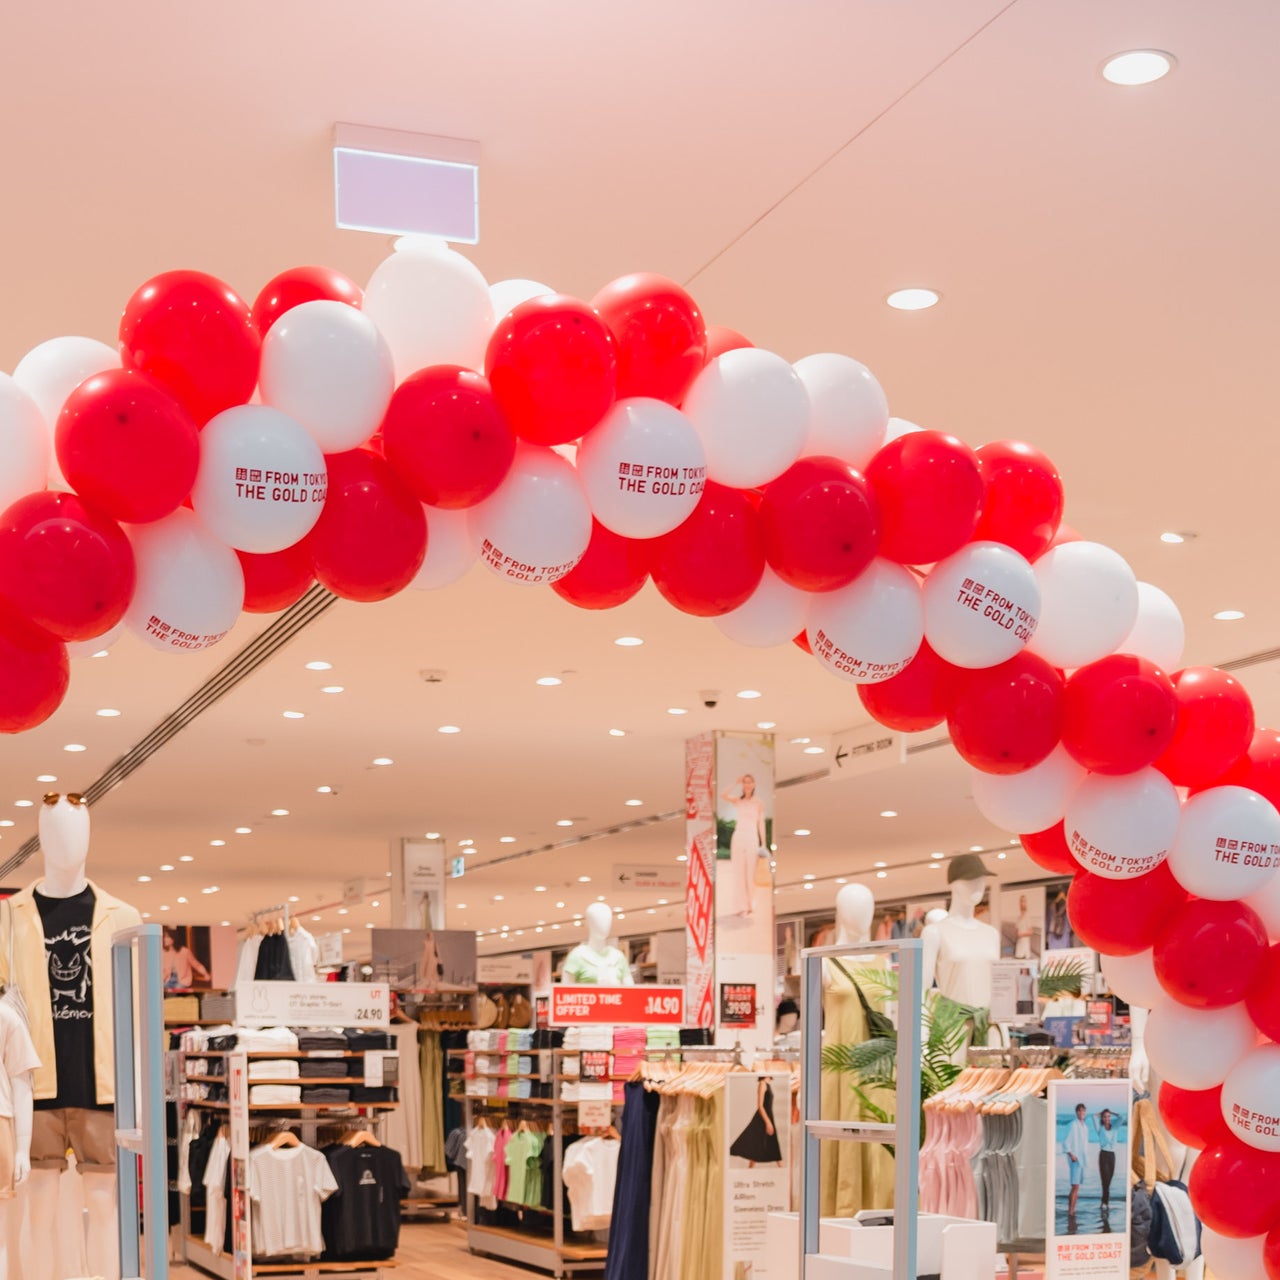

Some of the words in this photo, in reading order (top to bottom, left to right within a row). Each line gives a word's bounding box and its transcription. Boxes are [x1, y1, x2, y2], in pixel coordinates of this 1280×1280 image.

[265, 471, 299, 485] FROM
[646, 466, 678, 479] FROM
[235, 483, 266, 500] THE
[272, 488, 307, 502] GOLD
[618, 477, 647, 493] THE
[652, 481, 685, 495] GOLD
[480, 549, 502, 570] THE
[505, 569, 542, 582] GOLD
[503, 556, 536, 574] FROM
[541, 560, 573, 574] TOKYO
[984, 589, 1013, 612] FROM
[956, 590, 979, 612] THE
[983, 605, 1014, 631] GOLD
[145, 623, 169, 642] THE
[171, 638, 202, 650] GOLD
[171, 628, 200, 642] FROM
[814, 639, 831, 662] THE
[834, 659, 868, 678] GOLD
[833, 647, 863, 668] FROM
[866, 661, 899, 671] TOKYO
[1240, 841, 1267, 853] FROM
[1070, 839, 1088, 862] THE
[1090, 857, 1123, 874] GOLD
[1087, 846, 1116, 864] FROM
[1119, 856, 1154, 867] TOKYO
[1215, 849, 1240, 864] THE
[1243, 854, 1271, 867] GOLD
[556, 994, 597, 1005] LIMITED
[599, 994, 623, 1005] TIME
[556, 1005, 590, 1016] OFFER
[1232, 1113, 1251, 1131] THE
[1251, 1112, 1280, 1125] FROM
[1057, 1253, 1073, 1262] THE
[1075, 1252, 1095, 1260] GOLD
[1098, 1250, 1123, 1260] COAST
